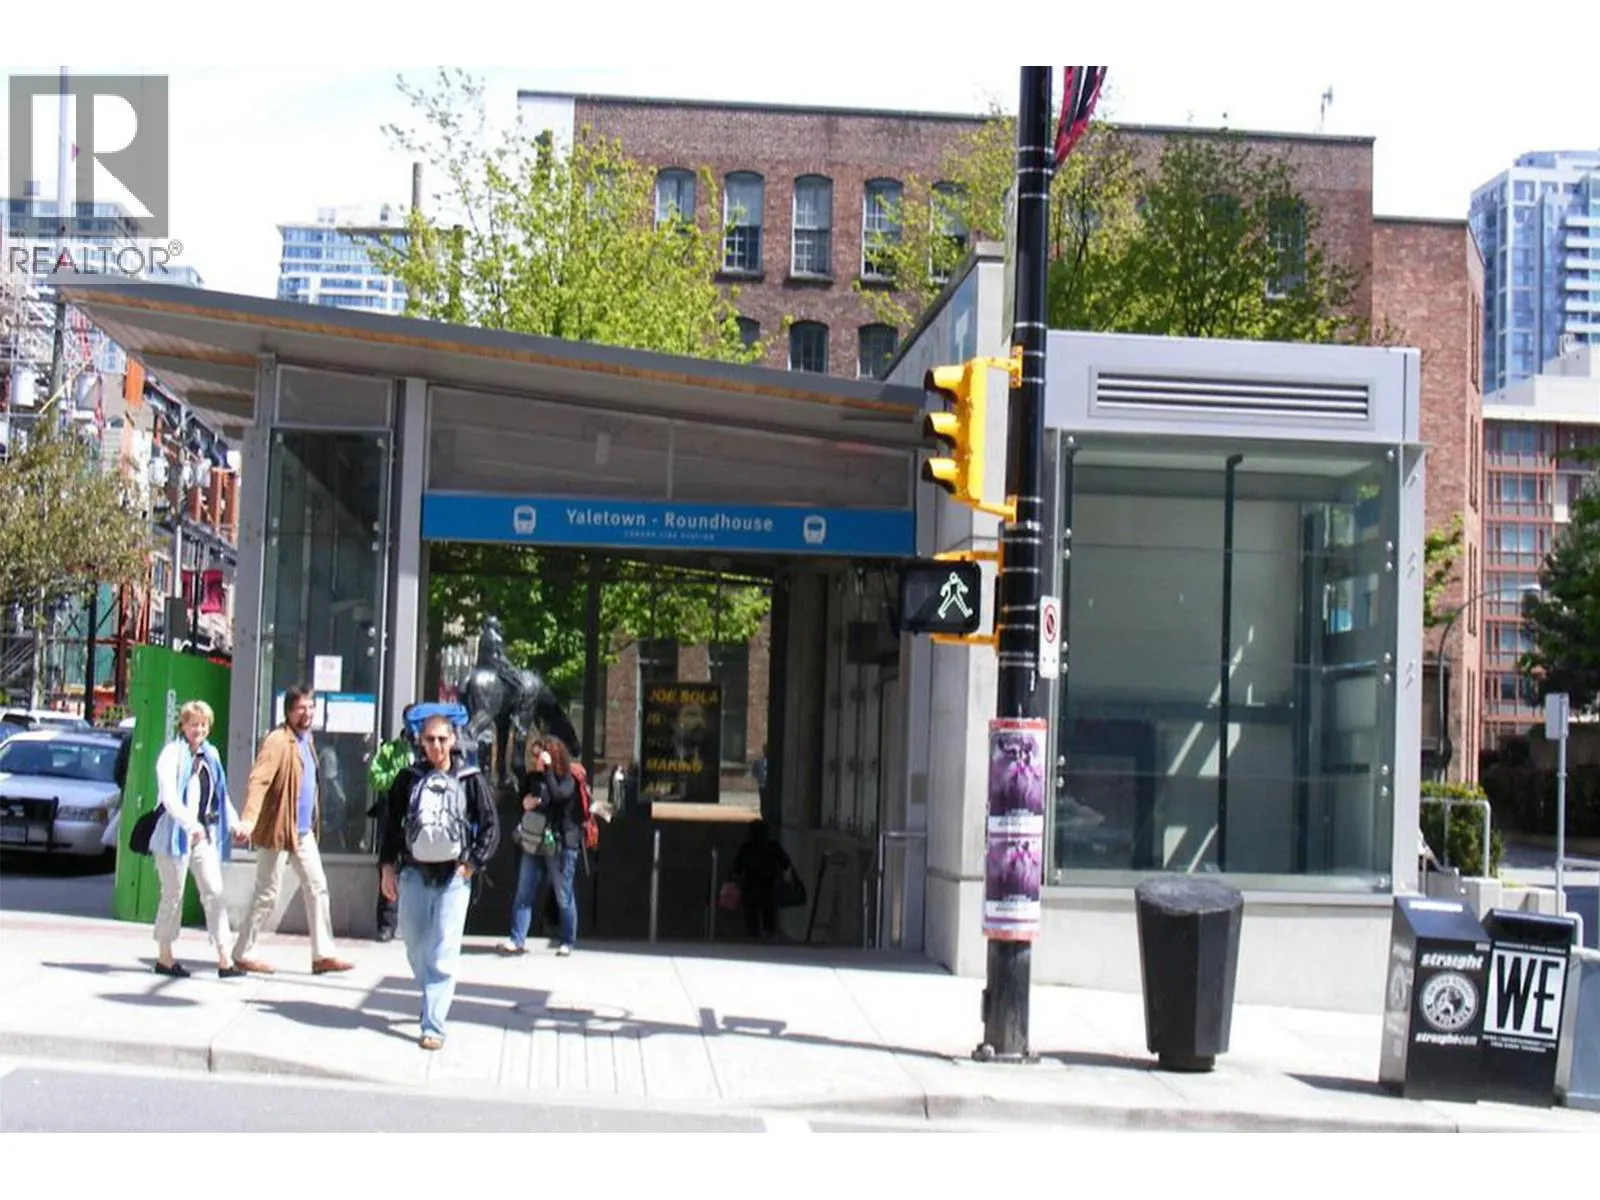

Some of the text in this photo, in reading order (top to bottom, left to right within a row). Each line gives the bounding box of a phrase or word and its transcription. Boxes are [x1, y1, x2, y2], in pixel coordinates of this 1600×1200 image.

[566, 508, 646, 526] Yaletown
[664, 511, 774, 532] Roundhouse
[1420, 953, 1484, 970] straight
[1496, 954, 1560, 1034] WE
